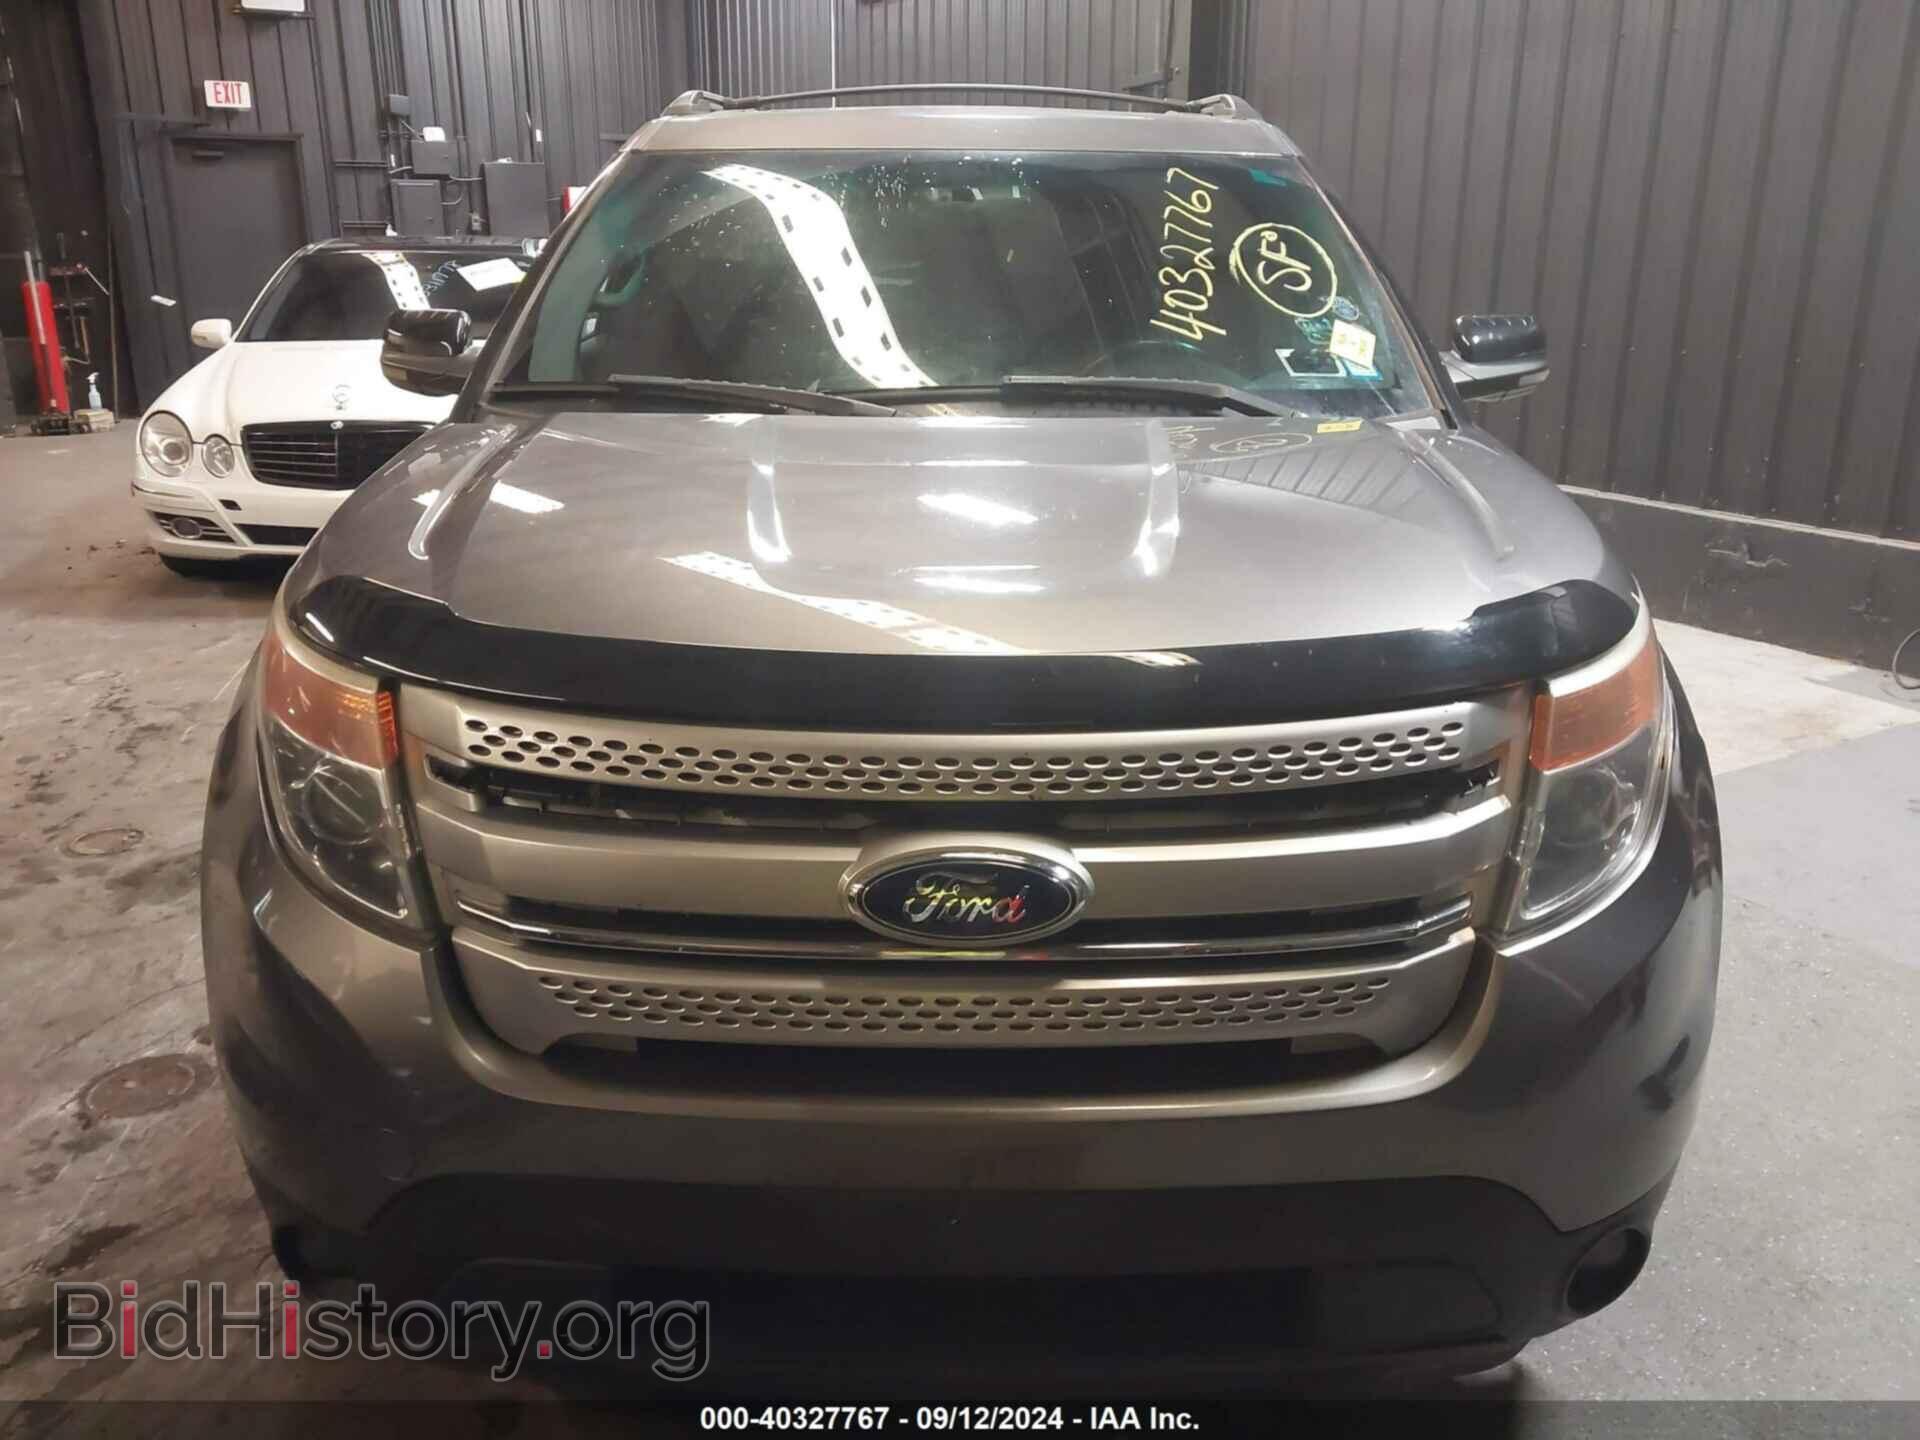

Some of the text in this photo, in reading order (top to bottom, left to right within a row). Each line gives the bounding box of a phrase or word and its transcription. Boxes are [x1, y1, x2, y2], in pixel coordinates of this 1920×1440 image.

[213, 82, 242, 105] EXIT
[1150, 167, 1228, 342] 40327767
[902, 869, 1030, 924] Ford
